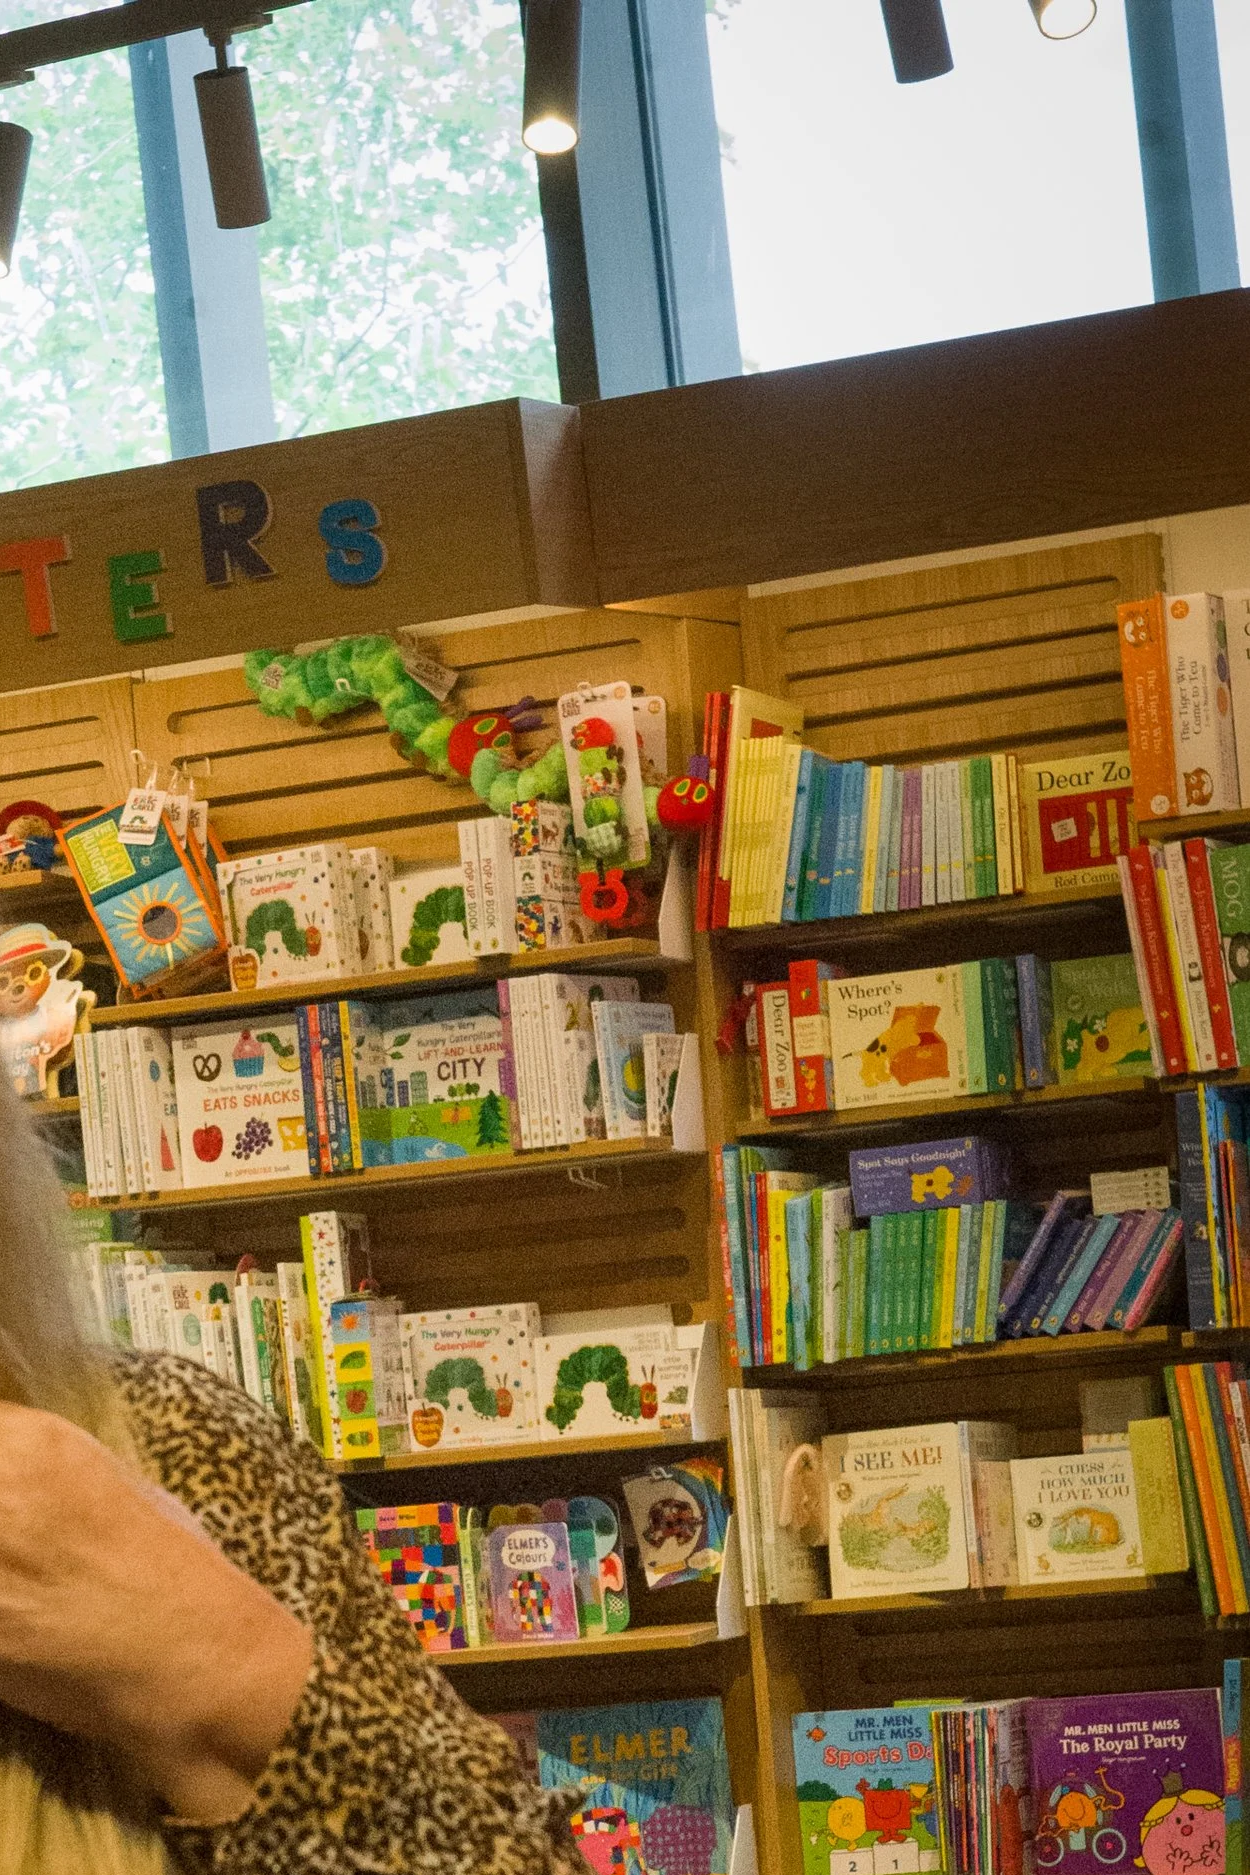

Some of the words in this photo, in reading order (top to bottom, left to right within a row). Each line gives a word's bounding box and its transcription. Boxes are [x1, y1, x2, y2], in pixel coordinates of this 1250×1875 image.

[1175, 656, 1186, 684] Who
[1189, 661, 1198, 685] Tea
[1179, 688, 1189, 720] Tiger
[1191, 689, 1201, 702] to
[1192, 703, 1202, 735] Came
[1152, 727, 1163, 754] Who
[1180, 723, 1190, 742] The
[1038, 770, 1094, 792] Dear
[1102, 761, 1131, 782] Zo
[255, 873, 273, 884] Very
[275, 867, 306, 879] Hungry
[1054, 874, 1077, 888] Rod
[251, 882, 294, 896] Caterpillar
[1171, 874, 1190, 907] MOG
[1216, 857, 1249, 920] MOG
[838, 980, 903, 1000] Where's
[773, 995, 787, 1036] Dear
[847, 1000, 892, 1021] Spot?
[458, 1021, 475, 1030] Very
[417, 1038, 446, 1048] Hungry
[776, 1042, 790, 1073] Zoo
[437, 1057, 485, 1081] CITY
[203, 1095, 238, 1112] EATS
[243, 1089, 299, 1108] SNACKS
[857, 1159, 881, 1170] Spot
[883, 1157, 909, 1167] Says
[911, 1149, 966, 1163] Goodnight
[421, 1331, 437, 1339] The
[440, 1330, 462, 1338] Very
[465, 1327, 500, 1337] Hungry
[434, 1340, 486, 1351] Caterpillar
[839, 1455, 846, 1473] I
[853, 1452, 894, 1472] SEE
[901, 1445, 943, 1468] ME!
[1058, 1462, 1105, 1474] GUESS
[1040, 1477, 1074, 1490] HOW
[1080, 1473, 1125, 1486] MUCH
[1038, 1492, 1042, 1504] I
[1050, 1488, 1093, 1502] LOVE
[1099, 1485, 1130, 1498] YOU
[507, 1536, 549, 1550] ELMER'S
[508, 1552, 547, 1565] Colours
[855, 1717, 880, 1728] MR.
[883, 1715, 913, 1727] MEN
[1064, 1726, 1085, 1736] MR.
[1087, 1724, 1114, 1735] MEN
[1117, 1721, 1149, 1733] LITTLE
[1152, 1719, 1181, 1731] MISS
[849, 1729, 886, 1742] LITTLE
[890, 1727, 922, 1739] MISS
[1059, 1739, 1090, 1754] The
[1094, 1735, 1139, 1755] Royal
[1144, 1733, 1187, 1750] Party
[569, 1726, 693, 1765] ELMER
[823, 1746, 902, 1769] Sports
[849, 1861, 857, 1873] 2
[892, 1859, 899, 1869] 1
